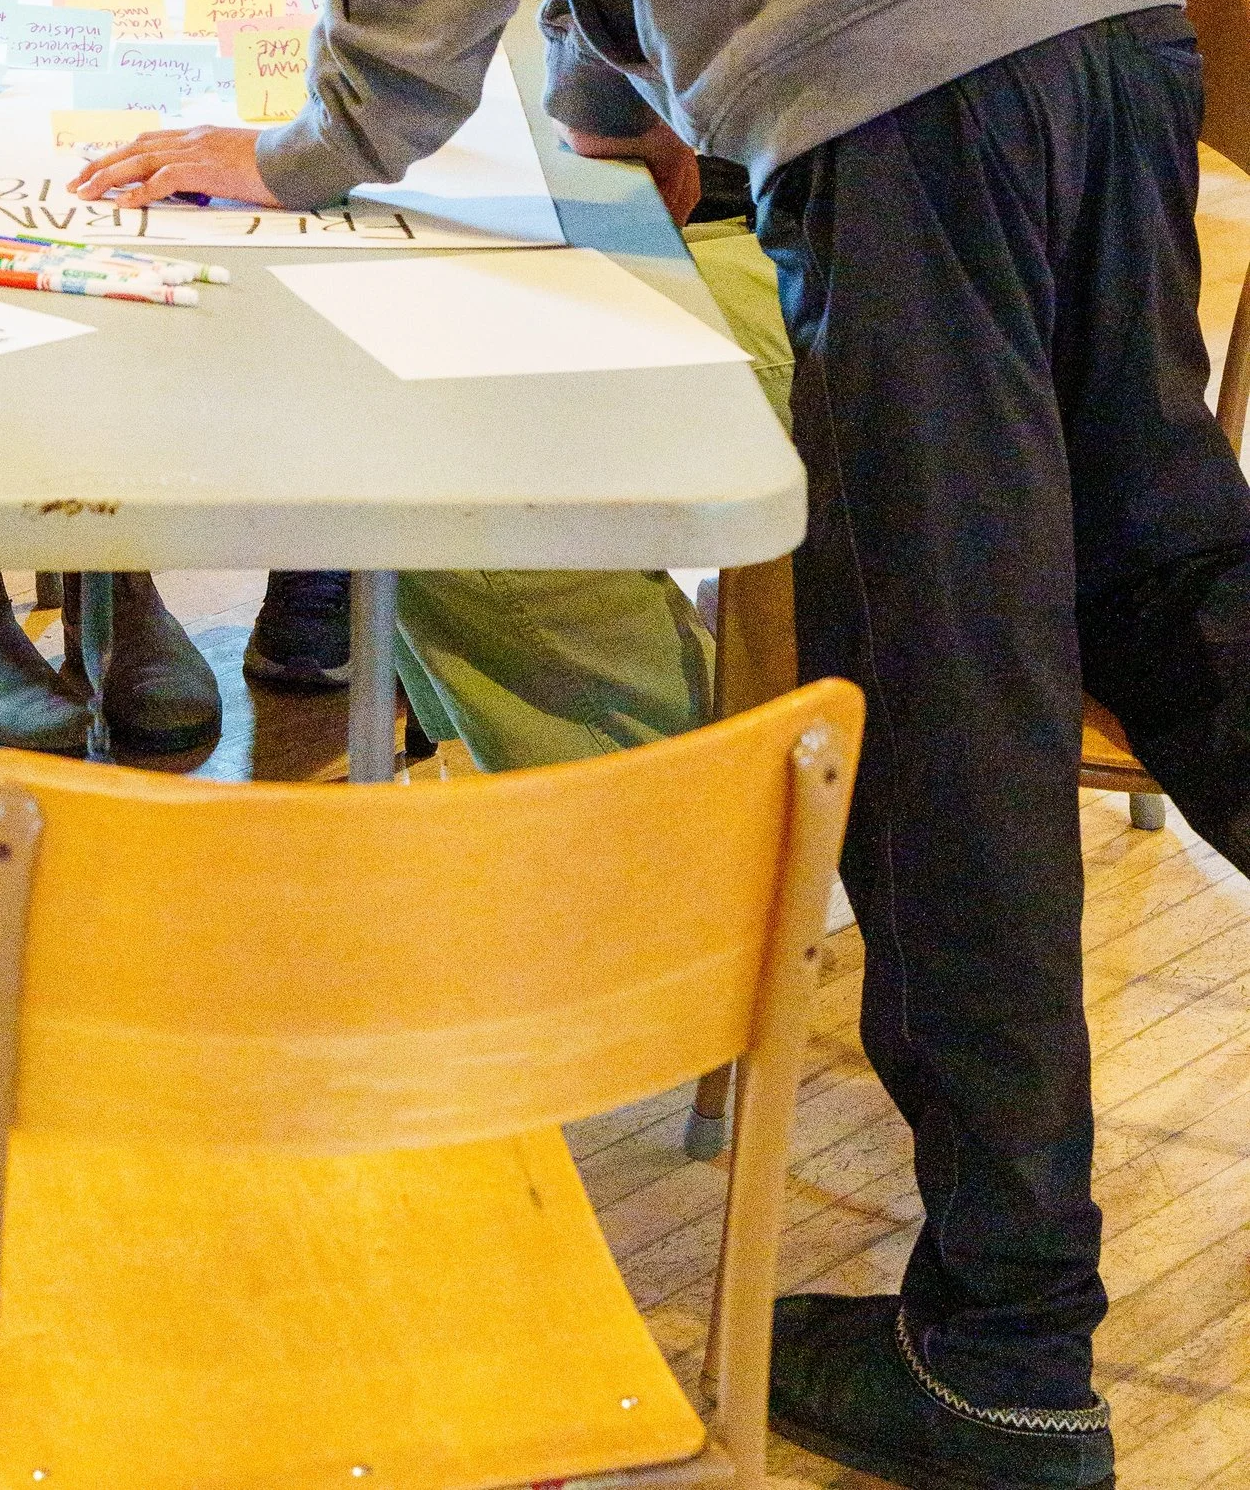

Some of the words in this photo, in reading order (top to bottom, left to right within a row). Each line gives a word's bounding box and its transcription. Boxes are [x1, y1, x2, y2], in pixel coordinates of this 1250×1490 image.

[206, 2, 273, 23] present
[25, 20, 101, 39] inclusive
[120, 49, 192, 77] thinking
[216, 209, 417, 240] FREE
